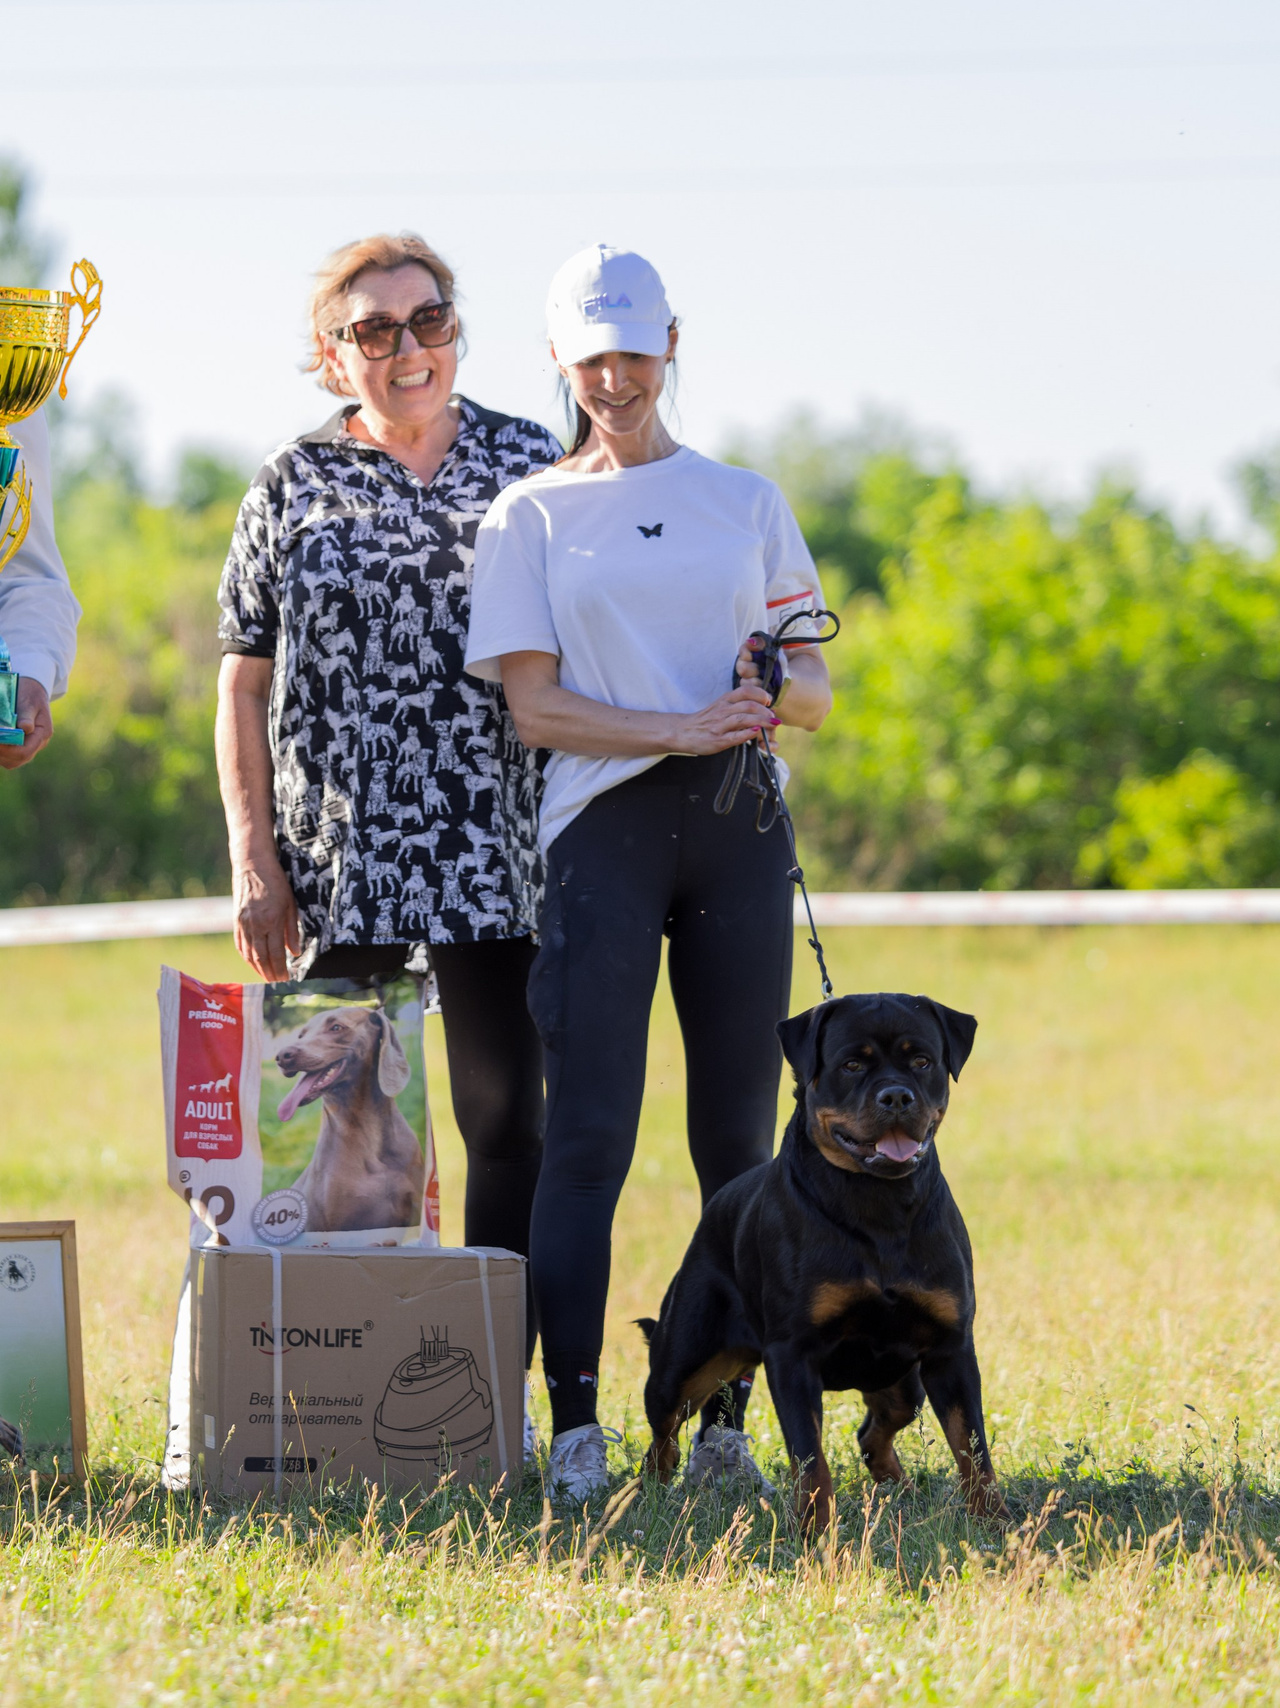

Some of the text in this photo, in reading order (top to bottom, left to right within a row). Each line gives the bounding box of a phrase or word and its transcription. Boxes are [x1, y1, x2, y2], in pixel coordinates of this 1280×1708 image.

[188, 1010, 237, 1025] PREMIUM
[200, 1021, 224, 1029] FOOD
[184, 1099, 234, 1120] ADULT
[199, 1122, 218, 1131] КОРМ
[183, 1131, 198, 1140] ДЛЯ
[197, 1141, 219, 1150] СОБАК
[264, 1208, 300, 1226] 40%
[324, 1328, 362, 1348] LIFE
